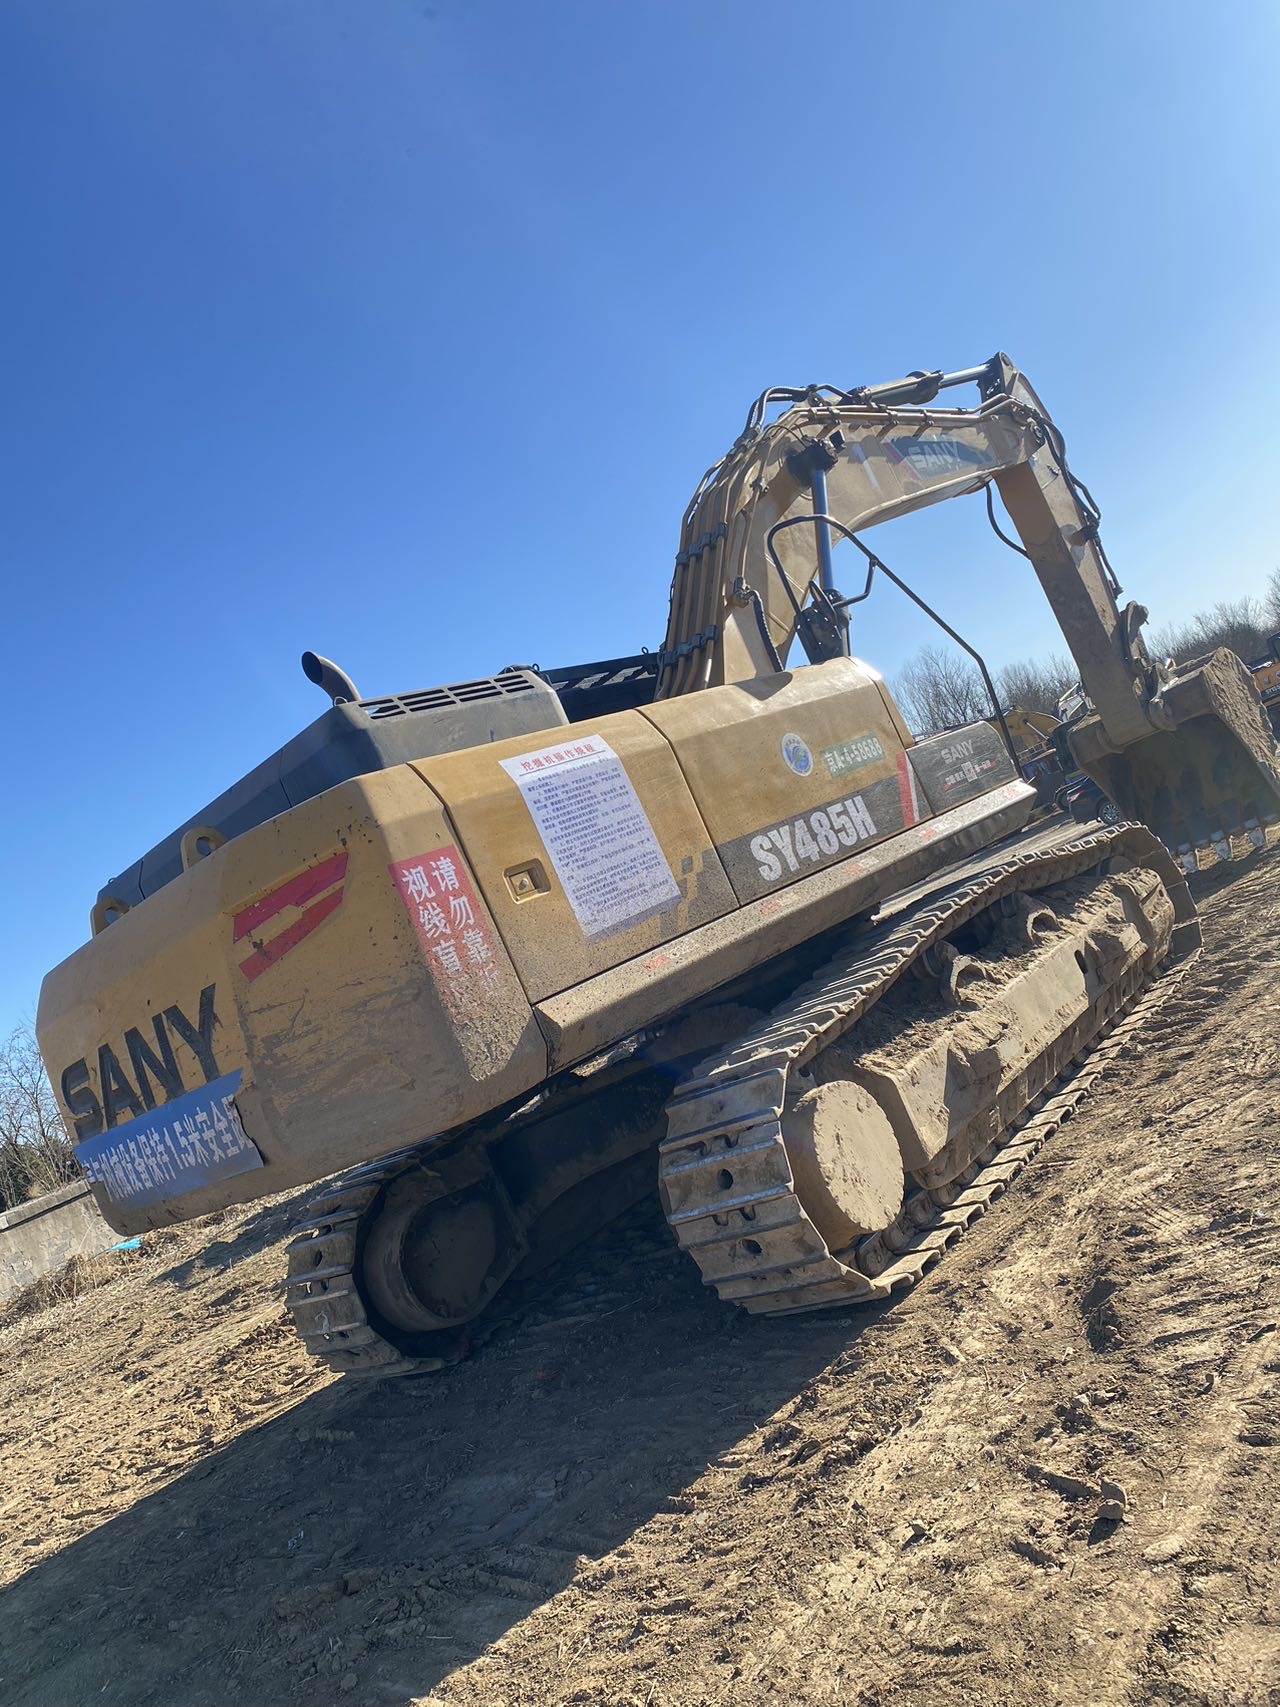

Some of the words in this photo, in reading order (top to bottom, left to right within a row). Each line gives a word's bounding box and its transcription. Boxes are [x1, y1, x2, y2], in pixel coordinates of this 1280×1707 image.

[910, 441, 960, 469] SANY
[940, 739, 975, 765] SANY
[750, 795, 877, 881] SY485H
[61, 983, 220, 1142] SANY
